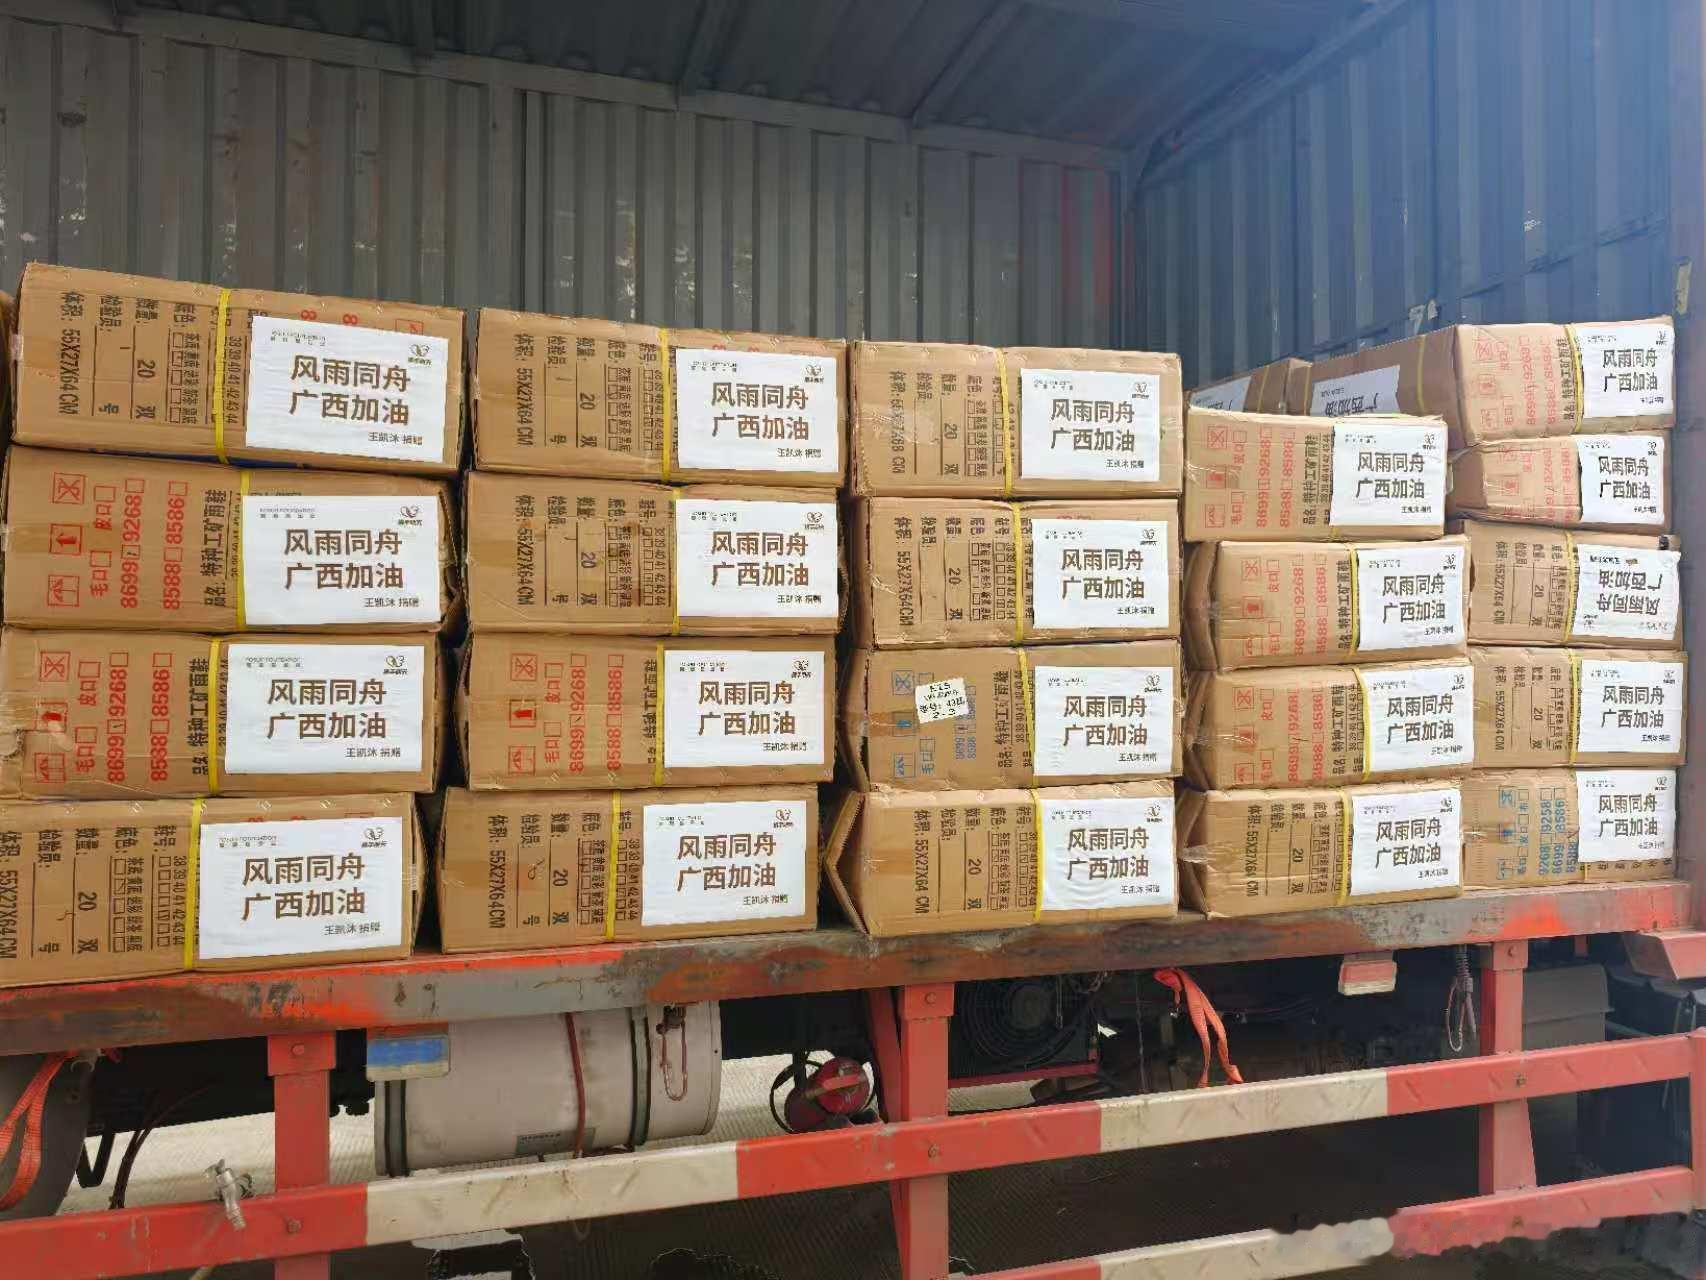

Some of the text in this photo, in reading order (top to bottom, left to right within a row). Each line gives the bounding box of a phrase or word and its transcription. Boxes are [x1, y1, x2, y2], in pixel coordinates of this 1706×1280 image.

[136, 359, 156, 379] 20
[1603, 348, 1657, 368] 风雨同舟
[291, 354, 411, 393] 风雨同舟
[1604, 373, 1658, 392] 广西加油
[580, 393, 595, 410] 20
[711, 382, 808, 409] 风雨同舟
[289, 392, 409, 426] 广西加油
[1051, 399, 1134, 423] 风雨同舟
[712, 413, 808, 441] 广西加油
[944, 424, 957, 440] 20
[1051, 428, 1134, 451] 广西加油
[1357, 452, 1424, 473] 风雨同舟
[1599, 456, 1648, 476] 风雨同舟
[1356, 479, 1425, 499] 广西加油
[1600, 480, 1650, 499] 广西加油
[121, 495, 142, 608] 8699 9268
[284, 528, 403, 555] 风雨同舟
[711, 531, 808, 556] 风雨同舟
[163, 498, 184, 609] 8588 8586
[581, 552, 595, 568] 20
[1061, 549, 1143, 571] 风雨同舟
[285, 562, 403, 590] 广西加油
[712, 562, 808, 587] 广西加油
[949, 568, 961, 584] 20
[1383, 575, 1445, 596] 风雨同舟
[1599, 569, 1662, 591] 广西加油
[1062, 576, 1144, 600] 广西加油
[1534, 585, 1544, 598] 20
[1383, 600, 1445, 623] 广西加油
[1596, 593, 1660, 615] 风雨同舟
[267, 678, 386, 705] 风雨同舟
[698, 681, 795, 706] 风雨同舟
[1603, 686, 1664, 705] 风雨同舟
[1064, 695, 1147, 717] 风雨同舟
[1387, 694, 1454, 717] 风雨同舟
[1533, 708, 1543, 721] 20
[108, 669, 127, 783] 8699 9268
[151, 669, 169, 782] 8588 8586
[267, 711, 386, 739] 广西加油
[569, 668, 586, 772] 8699 9268
[606, 669, 622, 771] 8588 8586
[698, 711, 796, 736] 广西加油
[1602, 709, 1664, 728] 广西加油
[1064, 724, 1147, 746] 广西加油
[1387, 720, 1454, 744] 广西加油
[1598, 794, 1657, 813] 风雨同舟
[1068, 826, 1149, 851] 风雨同舟
[1376, 817, 1441, 841] 风雨同舟
[1599, 818, 1658, 837] 广西加油
[677, 832, 777, 860] 风雨同舟
[1292, 849, 1304, 862] 20
[1376, 843, 1441, 868] 广西加油
[243, 854, 365, 886] 风雨同舟
[553, 870, 568, 887] 20
[677, 864, 776, 891] 广西加油
[967, 859, 981, 875] 20
[1068, 856, 1149, 880] 广西加油
[78, 891, 97, 911] 20
[240, 887, 366, 920] 广西加油
[78, 939, 98, 954] 双
